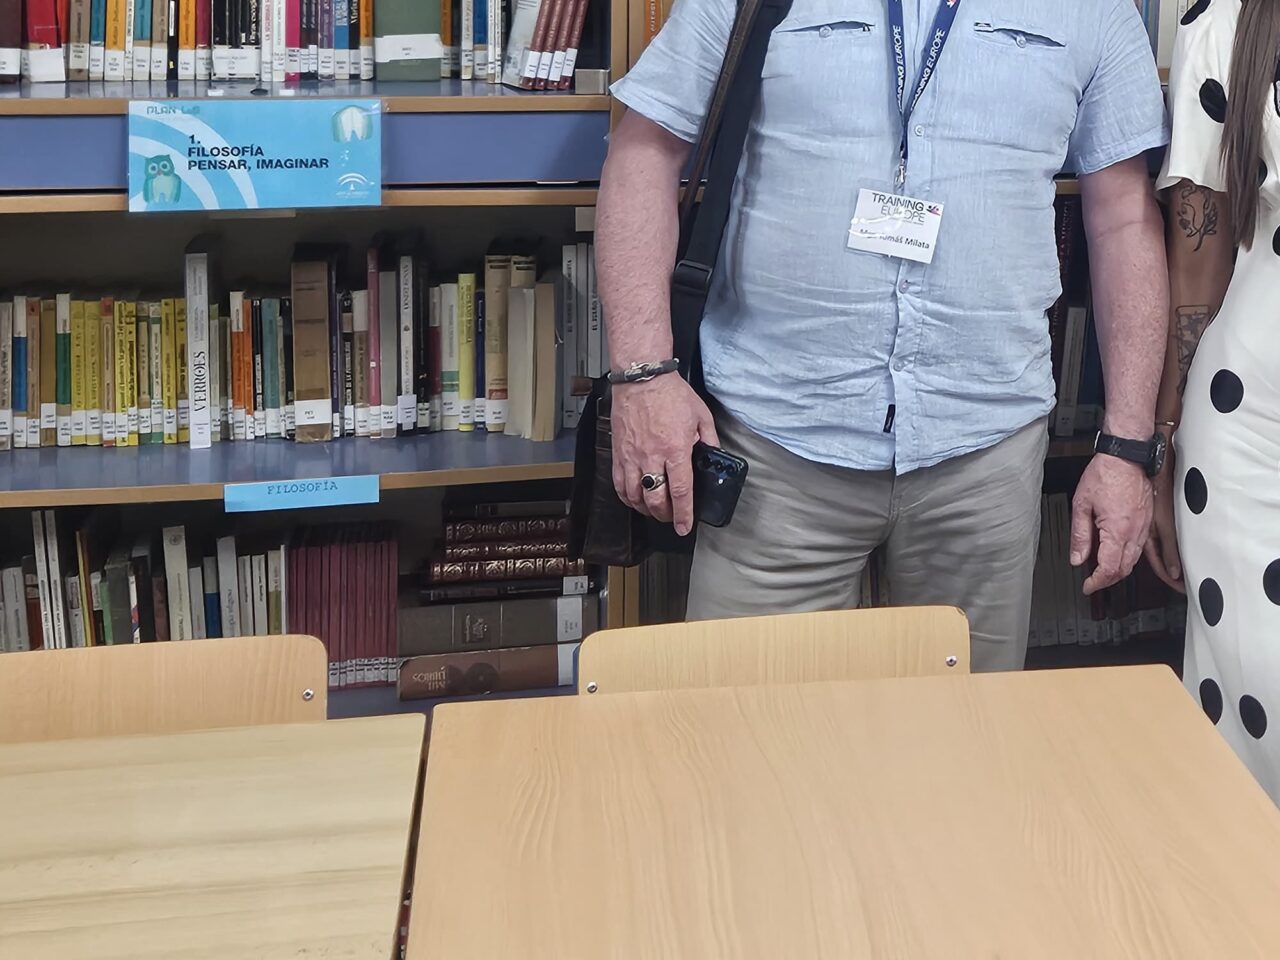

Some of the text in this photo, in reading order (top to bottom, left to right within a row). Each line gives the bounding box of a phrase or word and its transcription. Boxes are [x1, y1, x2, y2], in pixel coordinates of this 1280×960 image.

[893, 25, 903, 64] EUROPE
[926, 28, 946, 68] EUROPE
[188, 134, 201, 145] 1.
[188, 144, 264, 158] FILOSOFÍA
[188, 158, 329, 172] PENSAR, IMAGINAR
[872, 192, 924, 212] TRAINING
[904, 237, 930, 249] Milata
[266, 478, 338, 496] FILOSOFÍA
